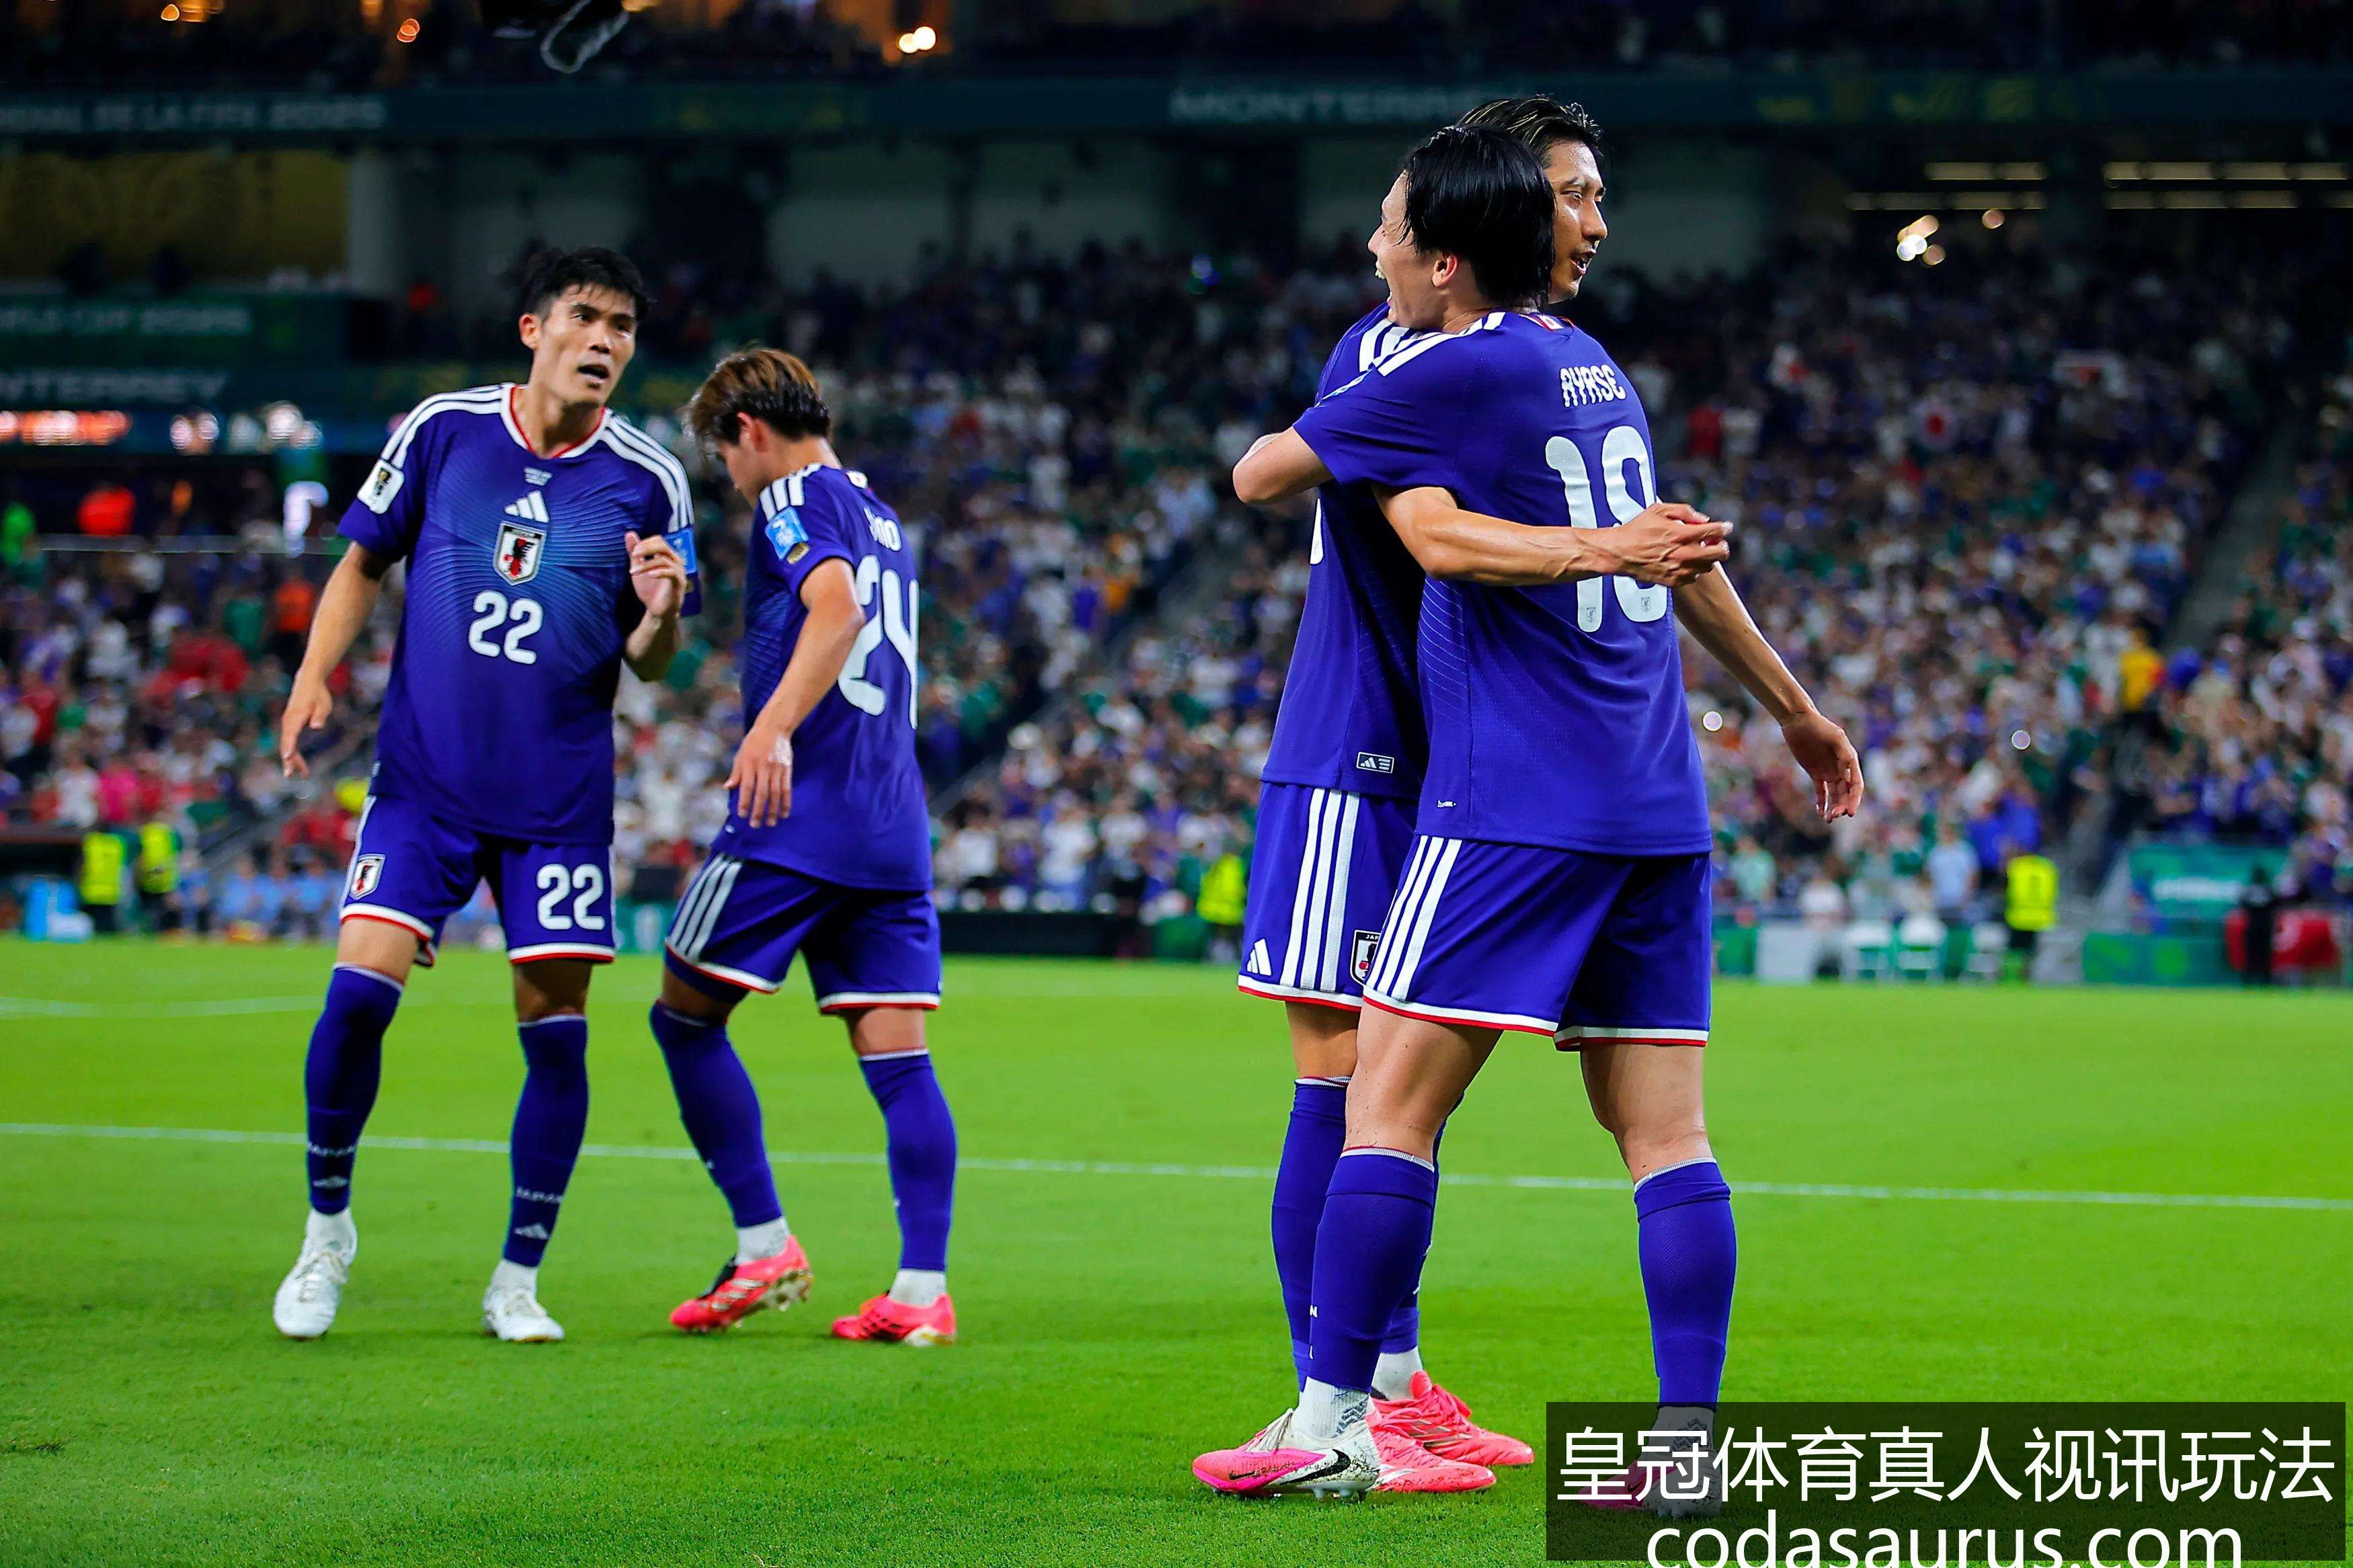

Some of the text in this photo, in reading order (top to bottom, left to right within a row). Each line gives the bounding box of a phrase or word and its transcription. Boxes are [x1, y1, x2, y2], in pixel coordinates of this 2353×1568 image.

[468, 589, 544, 665] 22
[837, 554, 919, 730] 24
[536, 863, 605, 930] 22
